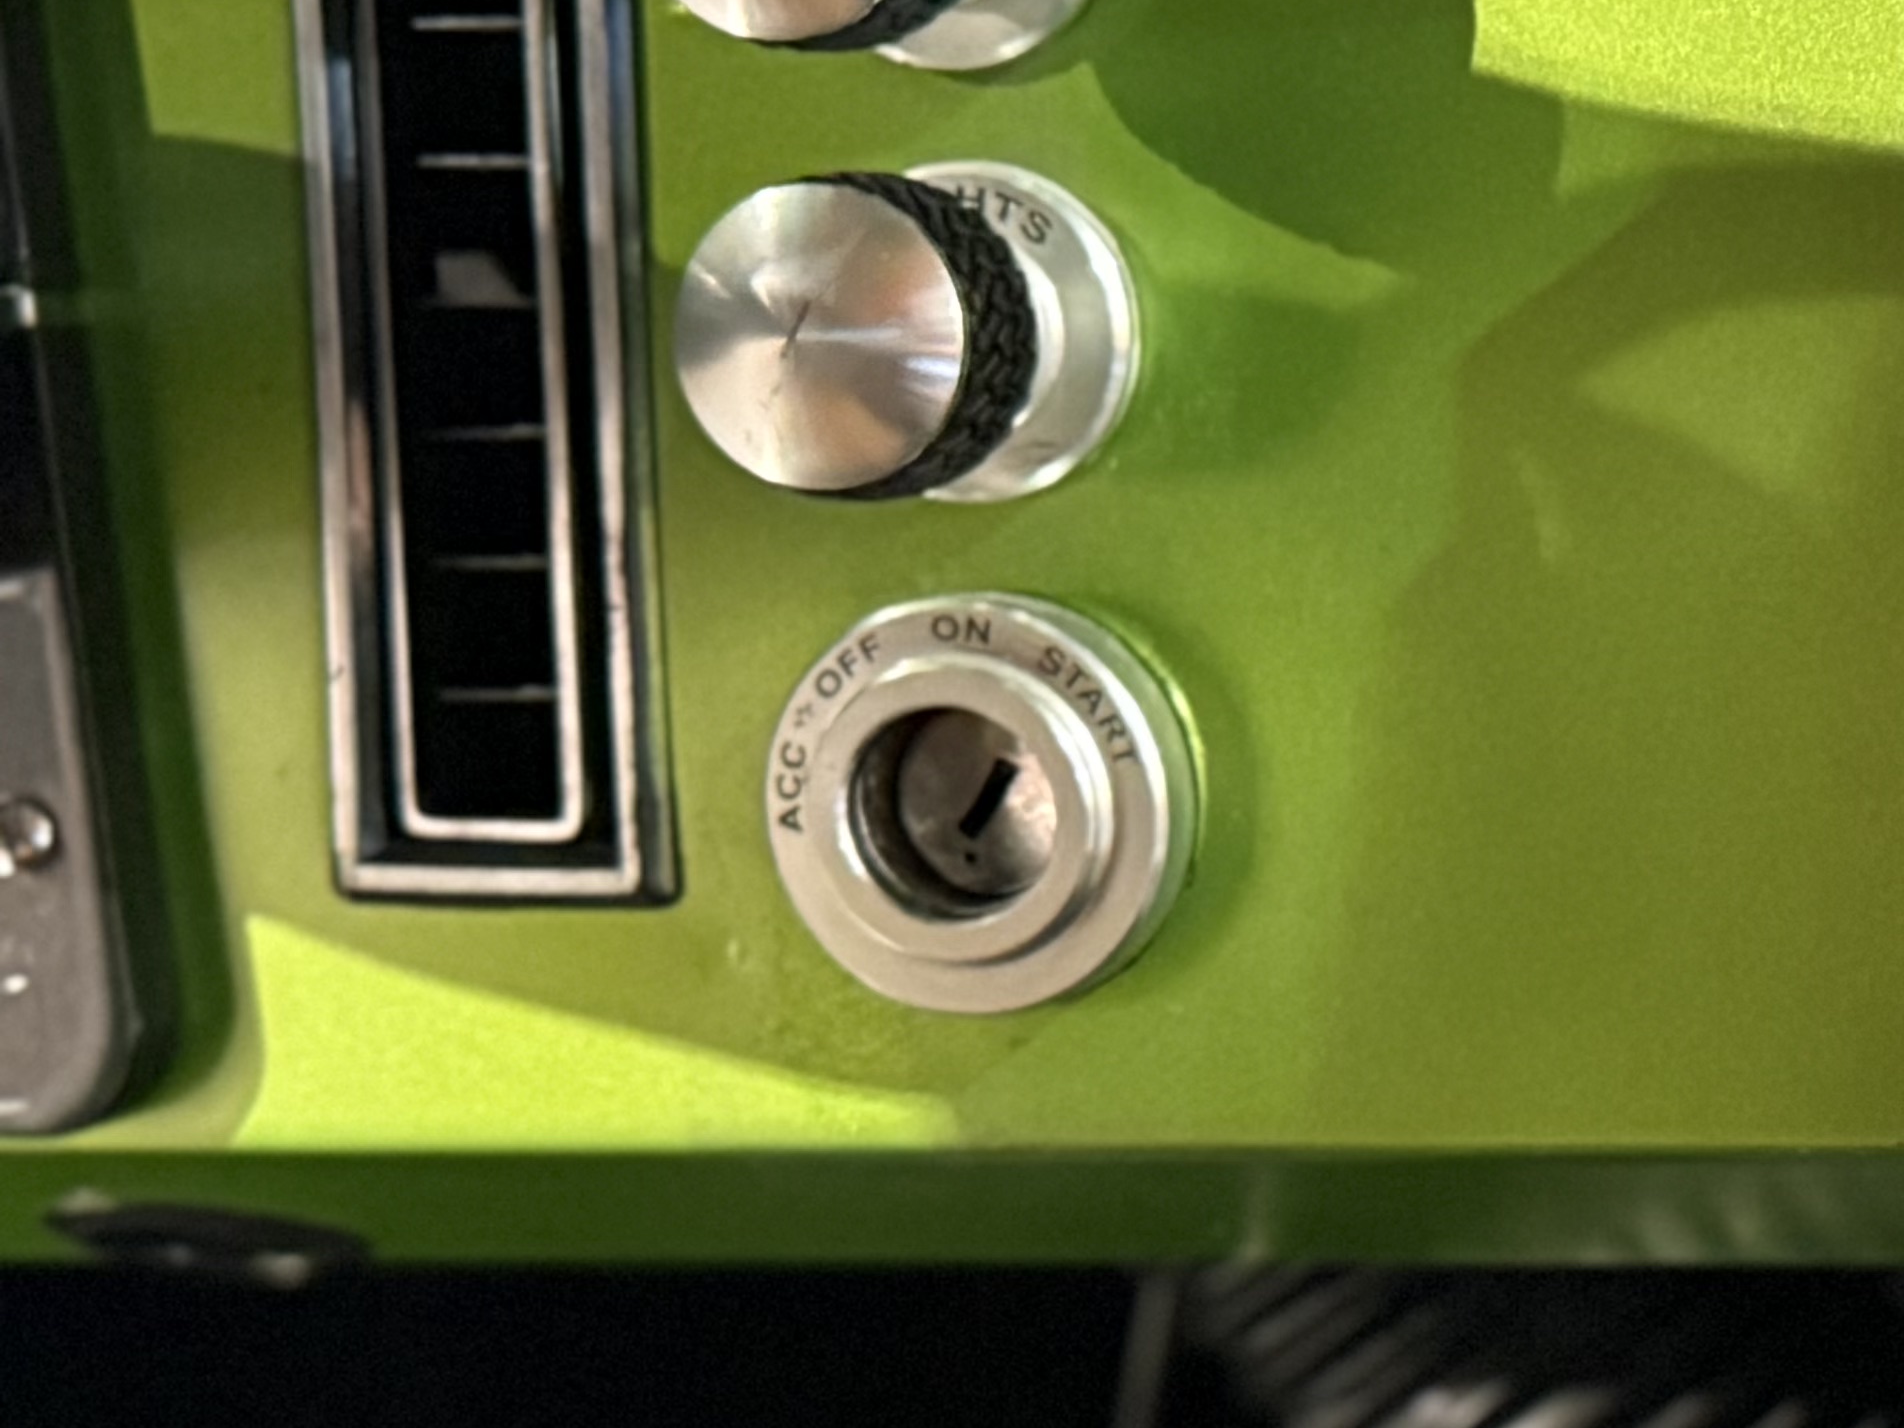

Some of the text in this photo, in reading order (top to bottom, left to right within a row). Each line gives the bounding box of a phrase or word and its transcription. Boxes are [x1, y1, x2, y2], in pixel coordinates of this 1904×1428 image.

[957, 185, 1053, 244] HTS
[777, 613, 1138, 834] ACC OFF ON START
